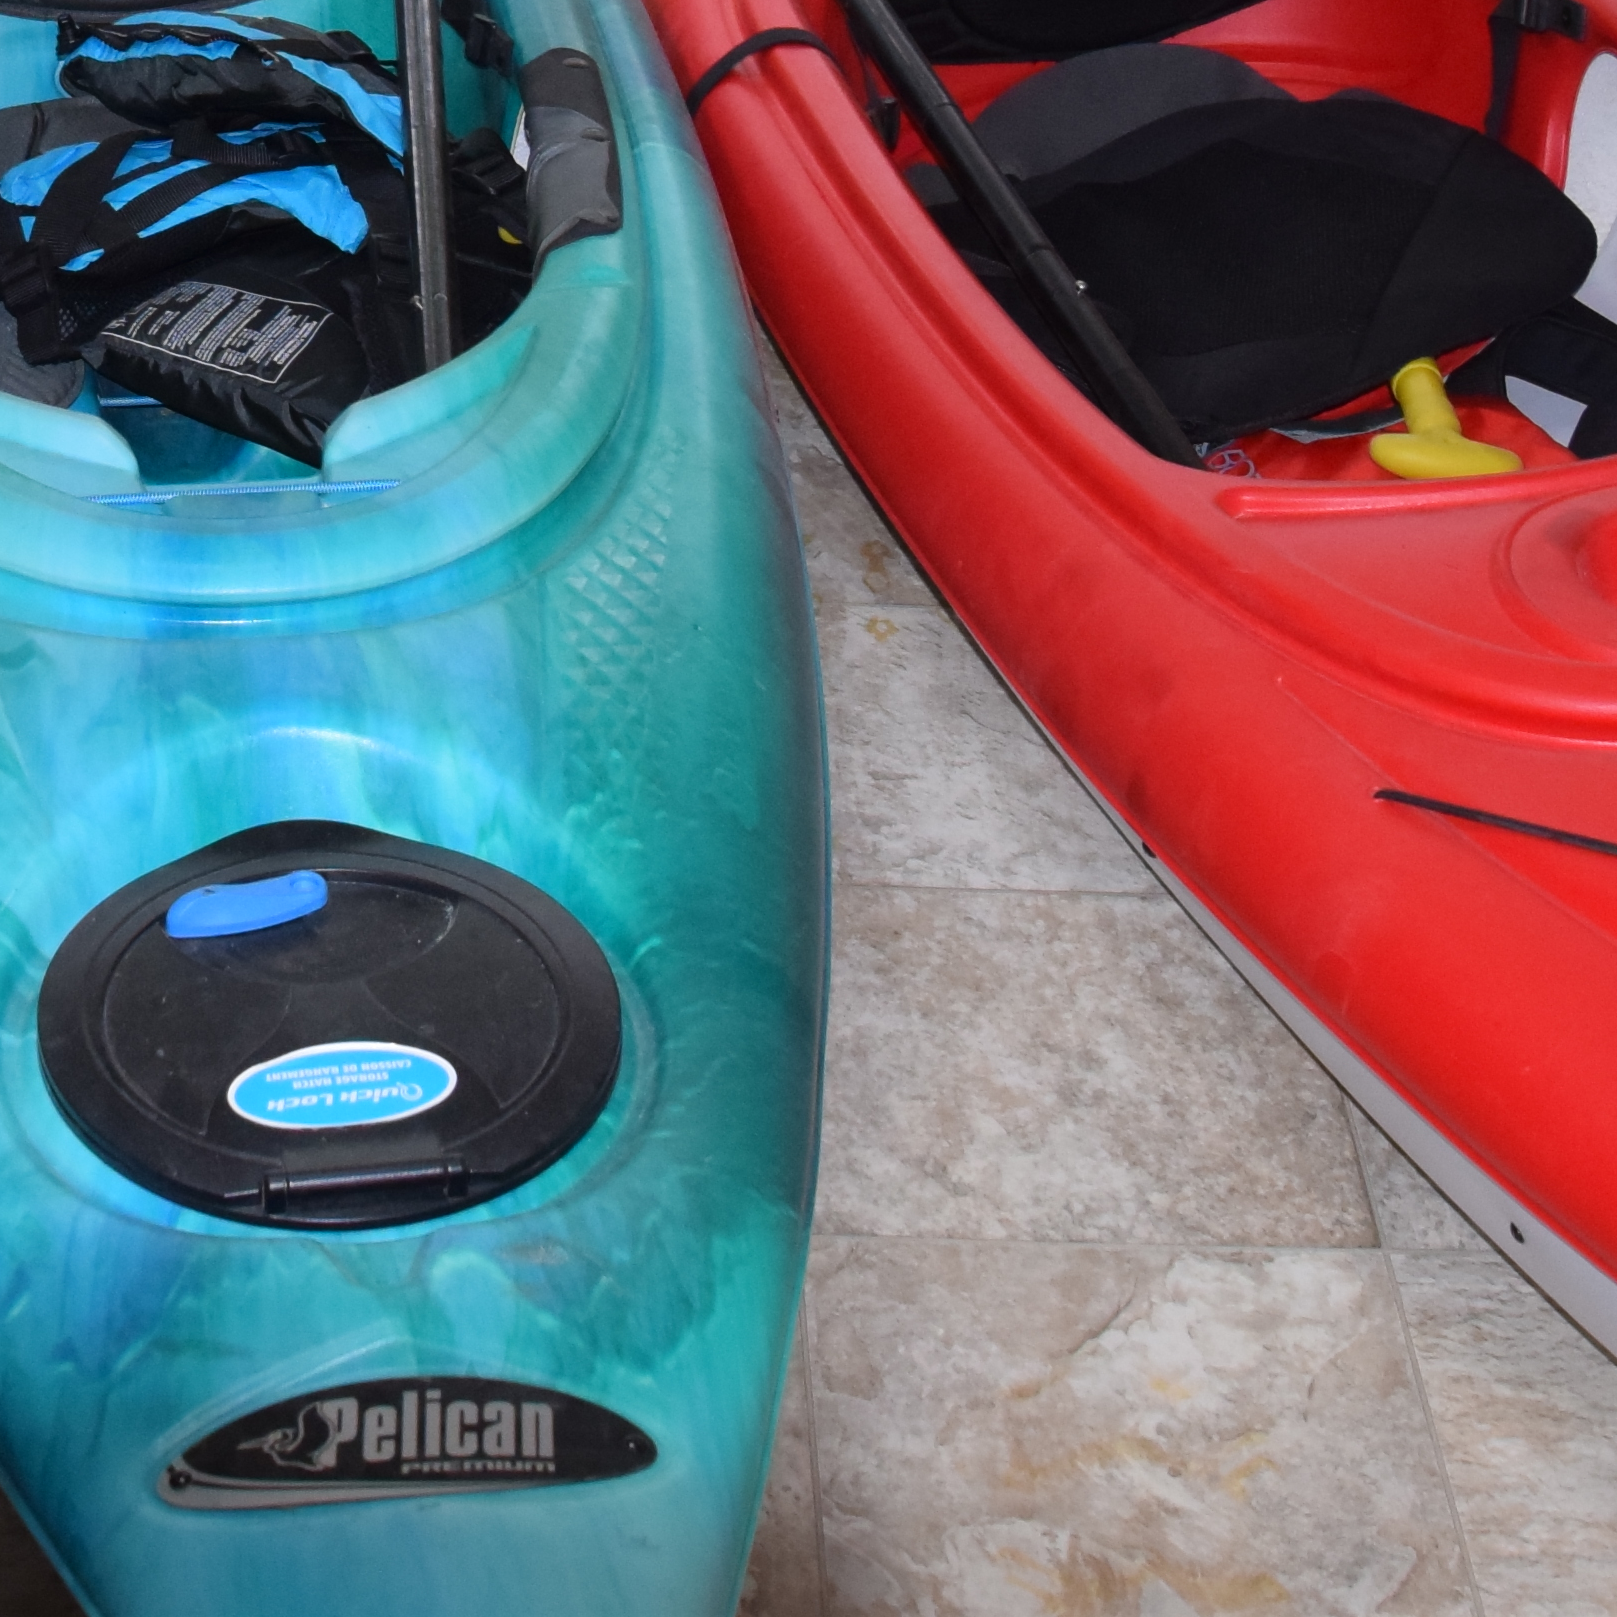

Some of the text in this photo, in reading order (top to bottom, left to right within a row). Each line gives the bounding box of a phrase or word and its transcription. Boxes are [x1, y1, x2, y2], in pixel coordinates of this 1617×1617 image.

[266, 1059, 412, 1082] CAISSON DE RANGEMENT
[292, 1071, 389, 1090] STORAGE HATCH
[267, 1082, 423, 1112] Quick Lock
[319, 1388, 556, 1469] Pelican
